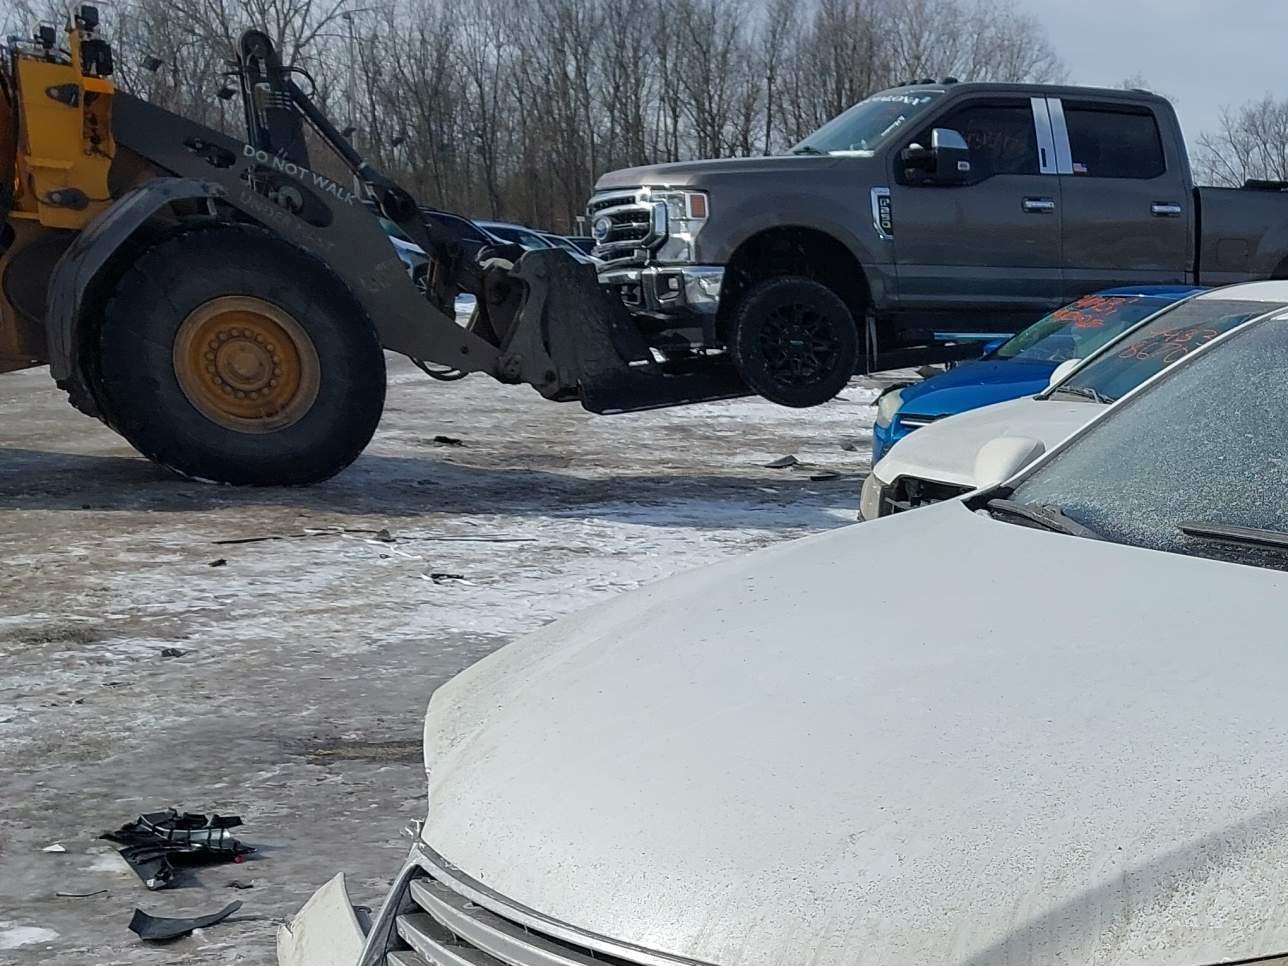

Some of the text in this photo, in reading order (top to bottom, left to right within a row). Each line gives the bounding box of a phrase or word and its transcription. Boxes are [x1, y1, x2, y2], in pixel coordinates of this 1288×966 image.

[243, 144, 361, 206] DO NOT WALK
